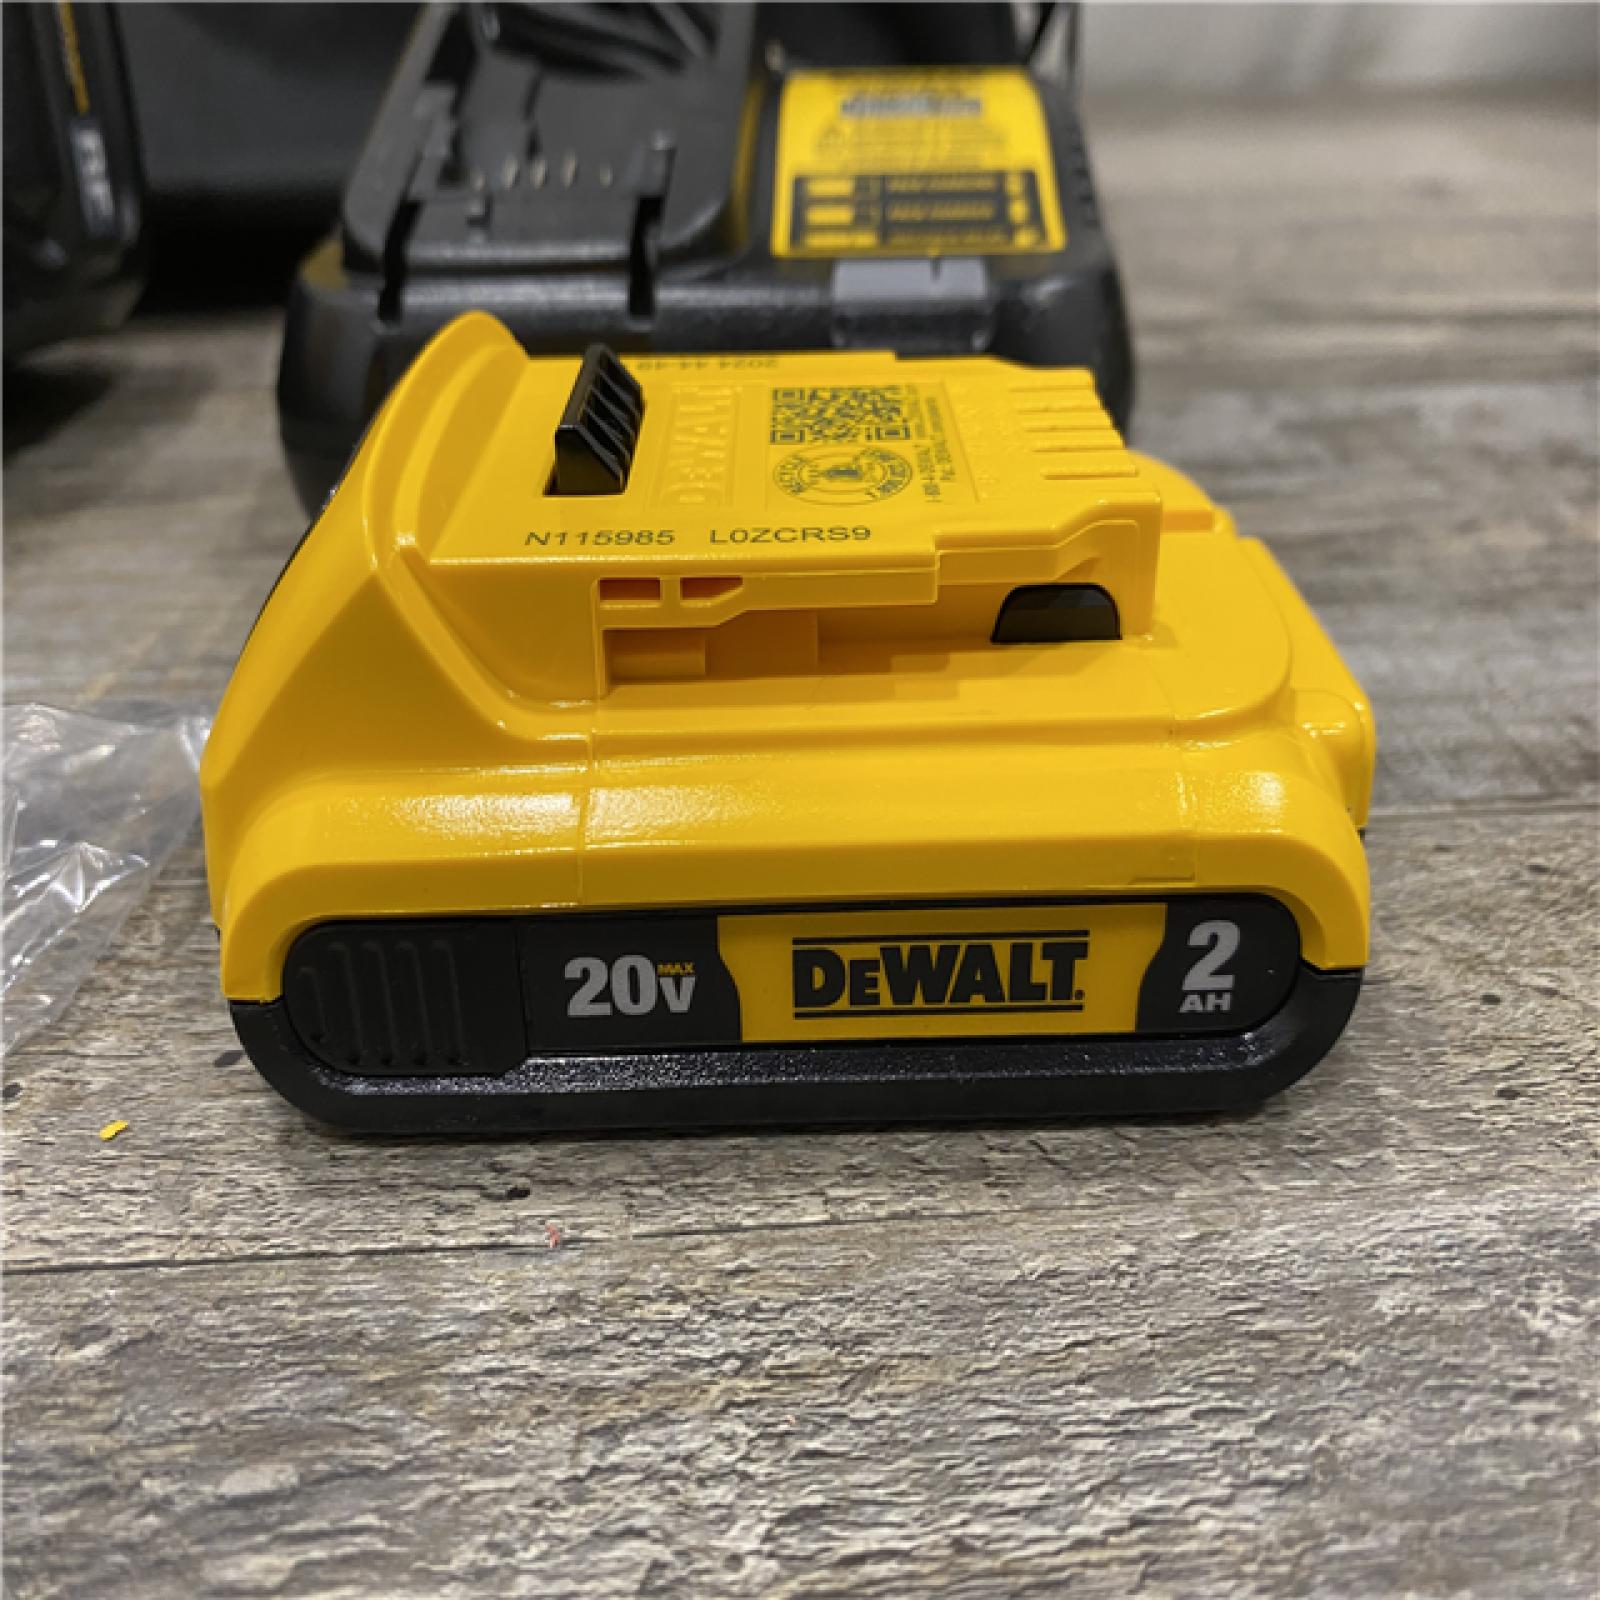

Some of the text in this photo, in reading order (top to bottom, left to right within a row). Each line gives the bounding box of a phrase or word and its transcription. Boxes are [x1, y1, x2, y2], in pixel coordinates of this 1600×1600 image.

[524, 529, 676, 546] N115985
[1181, 919, 1241, 991] 2
[656, 962, 696, 976] MAX
[1179, 989, 1231, 1014] AH
